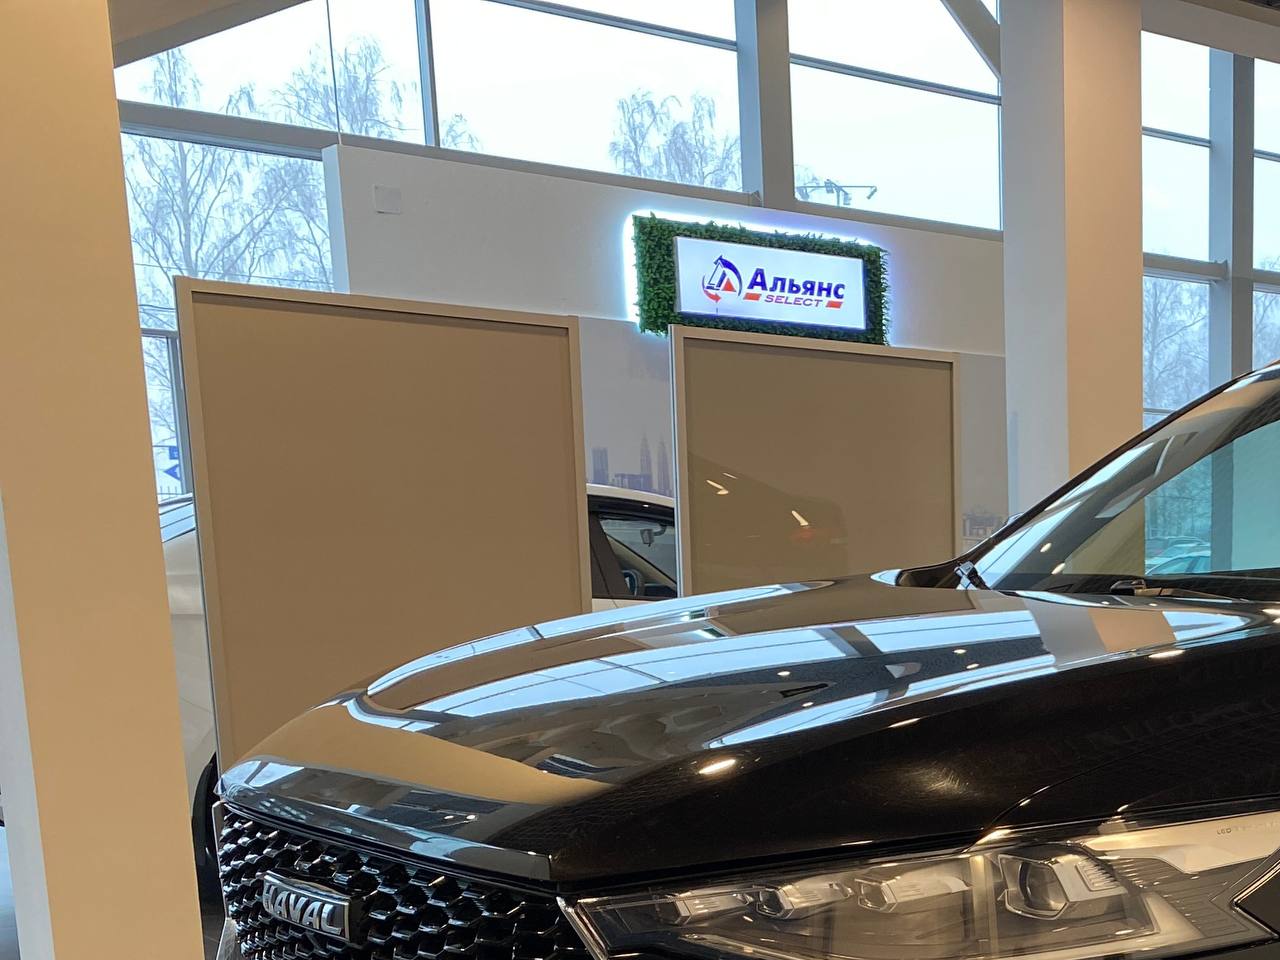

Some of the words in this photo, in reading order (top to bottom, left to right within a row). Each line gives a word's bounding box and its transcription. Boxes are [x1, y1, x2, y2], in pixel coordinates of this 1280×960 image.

[747, 268, 845, 299] Альянс
[764, 294, 823, 308] SELECT
[263, 882, 342, 935] HAVAL
